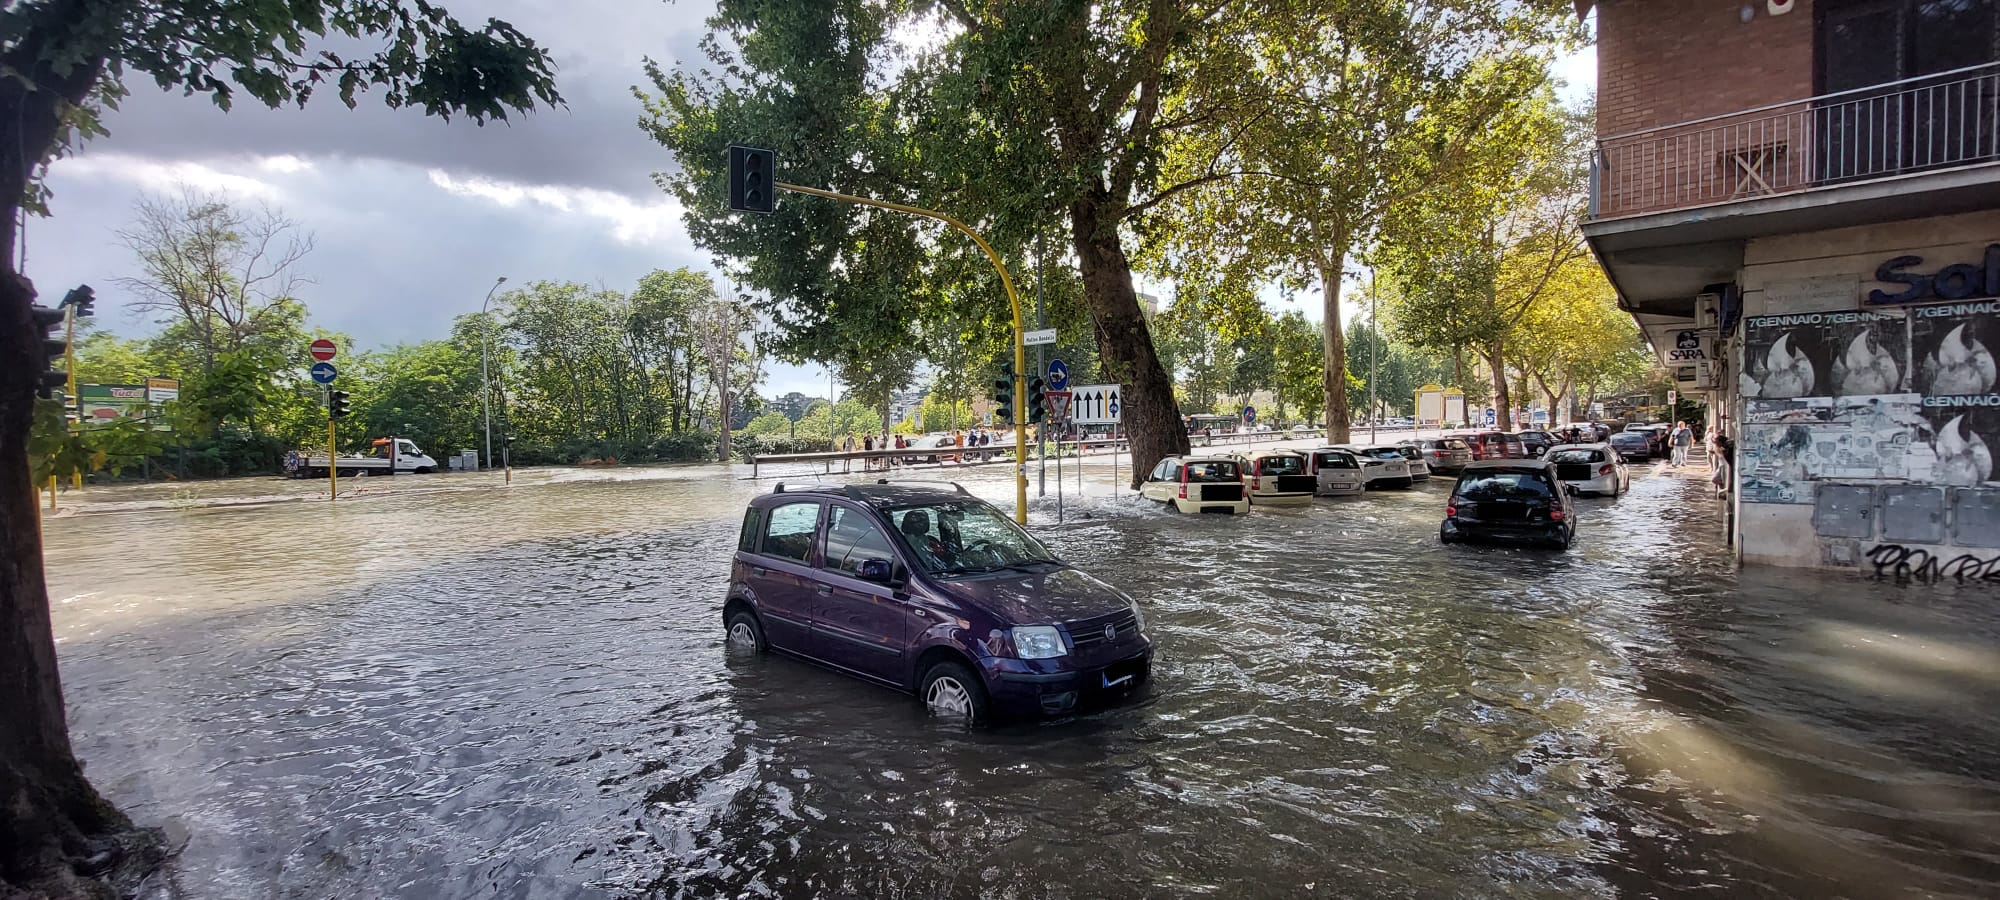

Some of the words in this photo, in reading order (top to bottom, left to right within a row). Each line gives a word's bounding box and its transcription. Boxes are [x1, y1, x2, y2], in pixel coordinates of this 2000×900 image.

[1750, 314, 1822, 328] 7GENNAIO
[1825, 312, 1891, 324] 7GENNA
[1670, 349, 1706, 360] SARA
[1922, 395, 2000, 407] GENNAIO
